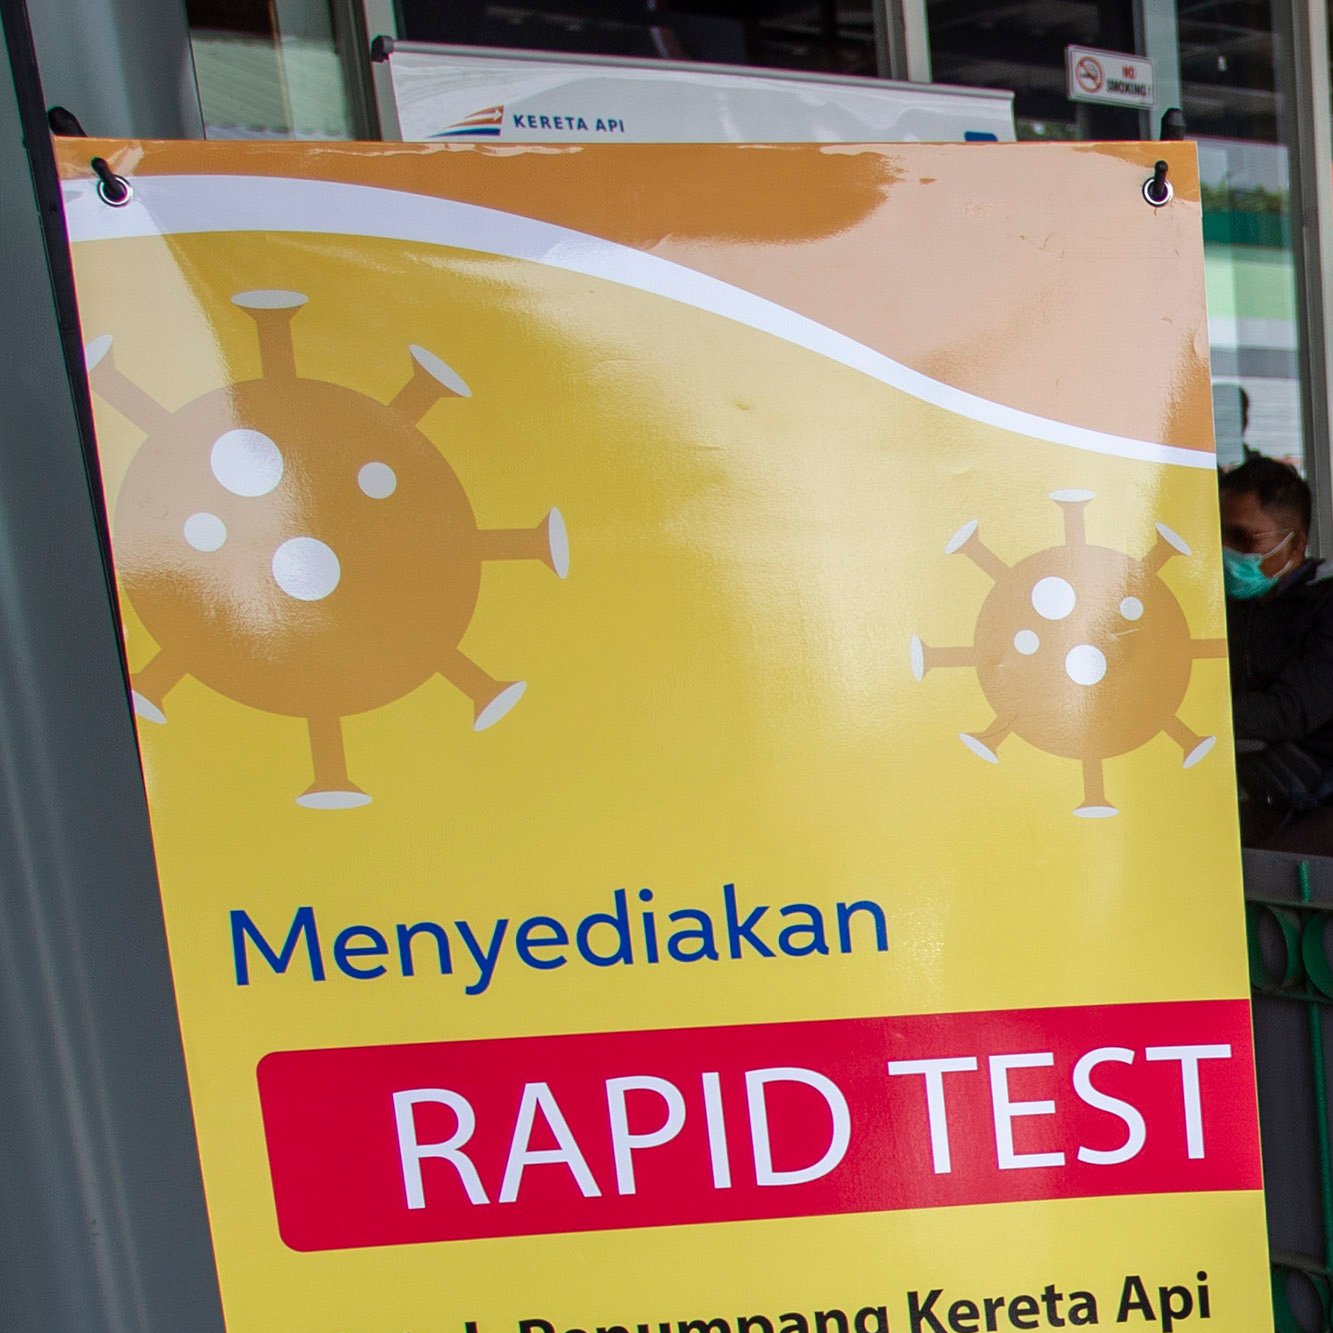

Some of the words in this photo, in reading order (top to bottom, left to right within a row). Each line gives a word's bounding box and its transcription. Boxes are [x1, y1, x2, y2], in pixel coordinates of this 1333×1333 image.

[1106, 78, 1147, 97] SMOKING
[1121, 63, 1136, 79] NO
[513, 114, 588, 131] KERETA
[596, 118, 625, 133] API
[230, 884, 888, 994] Menyediakan
[392, 1066, 850, 1210] RAPID
[887, 1044, 1231, 1176] TEST
[1115, 1270, 1211, 1332] Api
